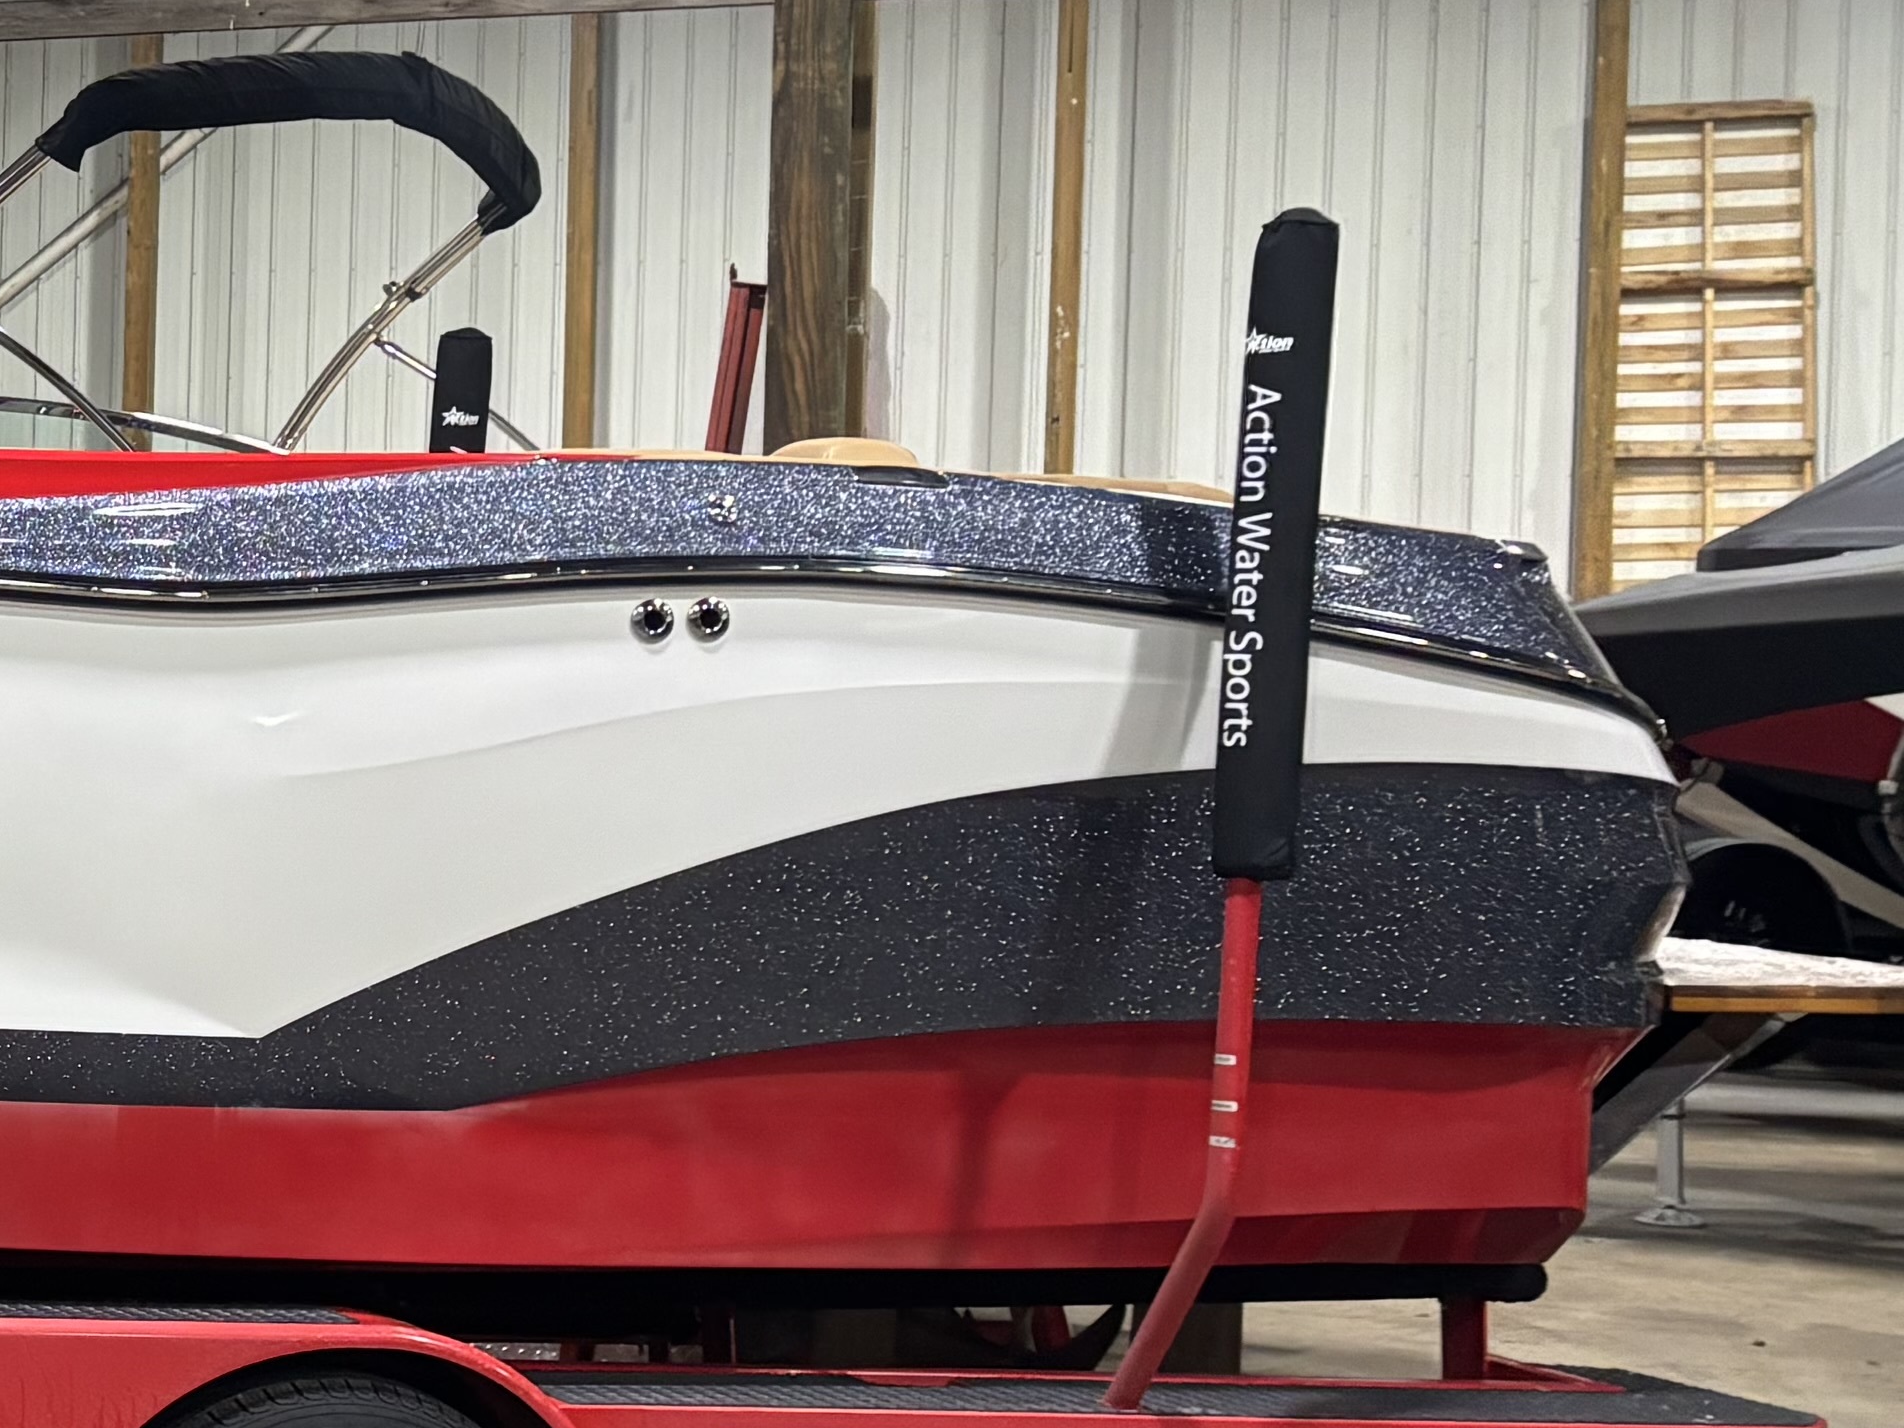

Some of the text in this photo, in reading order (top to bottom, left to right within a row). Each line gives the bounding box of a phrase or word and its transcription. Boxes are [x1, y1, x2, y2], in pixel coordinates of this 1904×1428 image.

[1239, 383, 1282, 503] Action
[1229, 512, 1274, 621] Water
[1222, 629, 1265, 749] Sports
